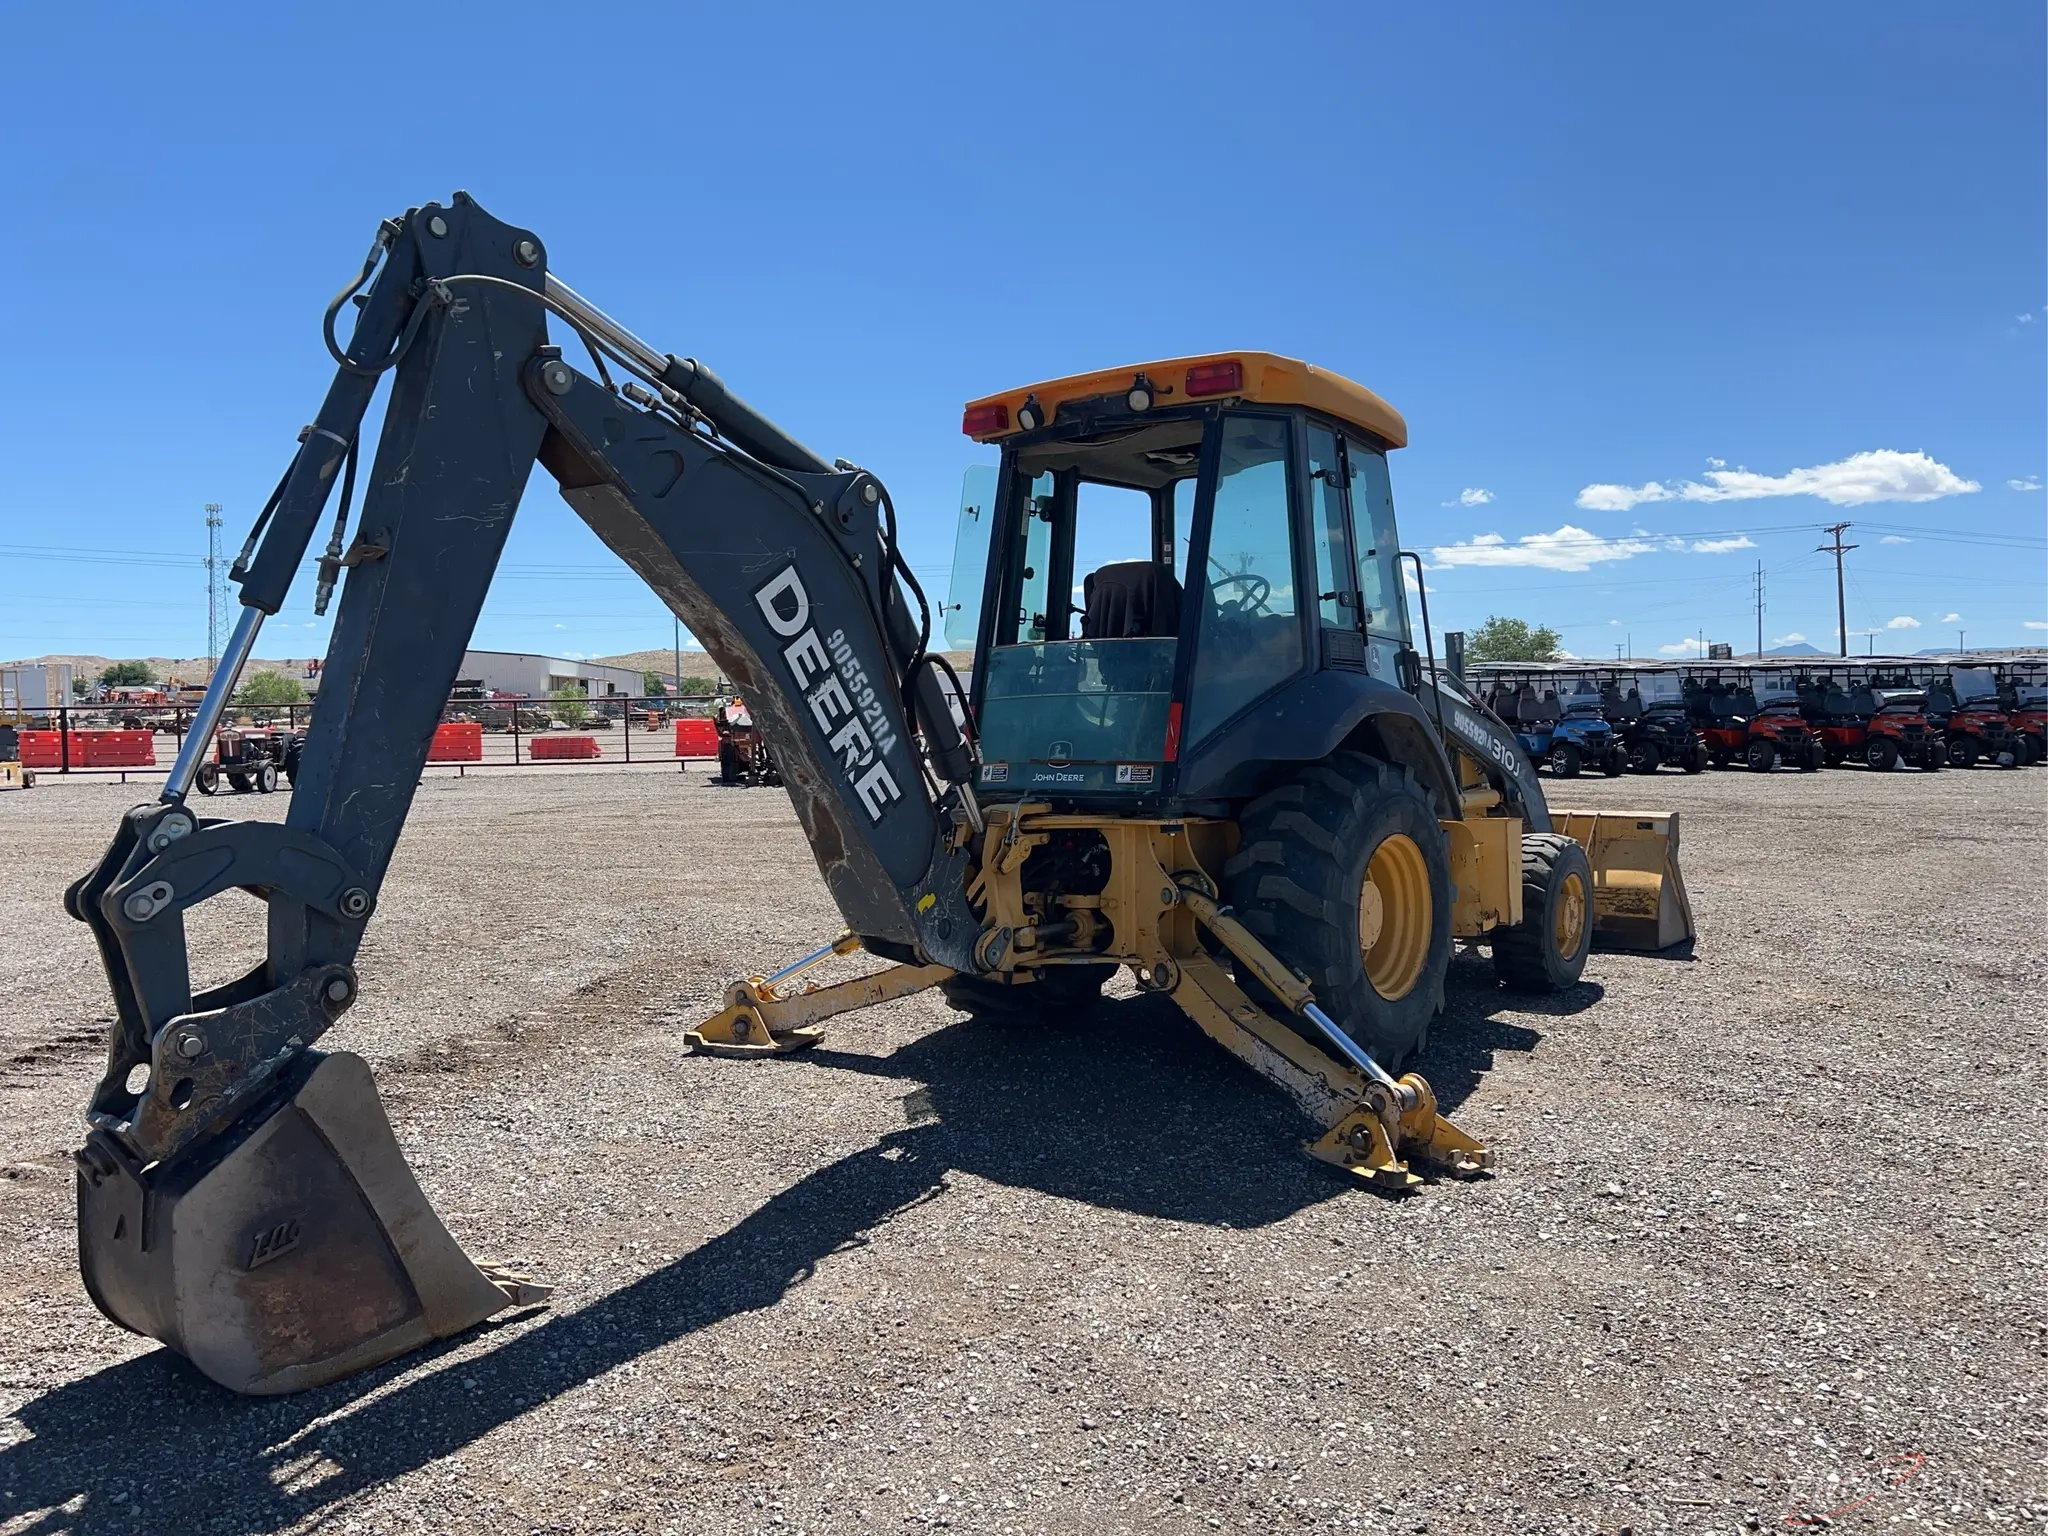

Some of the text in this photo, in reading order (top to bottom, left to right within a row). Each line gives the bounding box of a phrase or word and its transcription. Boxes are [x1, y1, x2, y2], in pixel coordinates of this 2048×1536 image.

[755, 565, 900, 821] DEERE
[1492, 738, 1520, 777] 310J
[1032, 773, 1085, 782] JOHN DEERE
